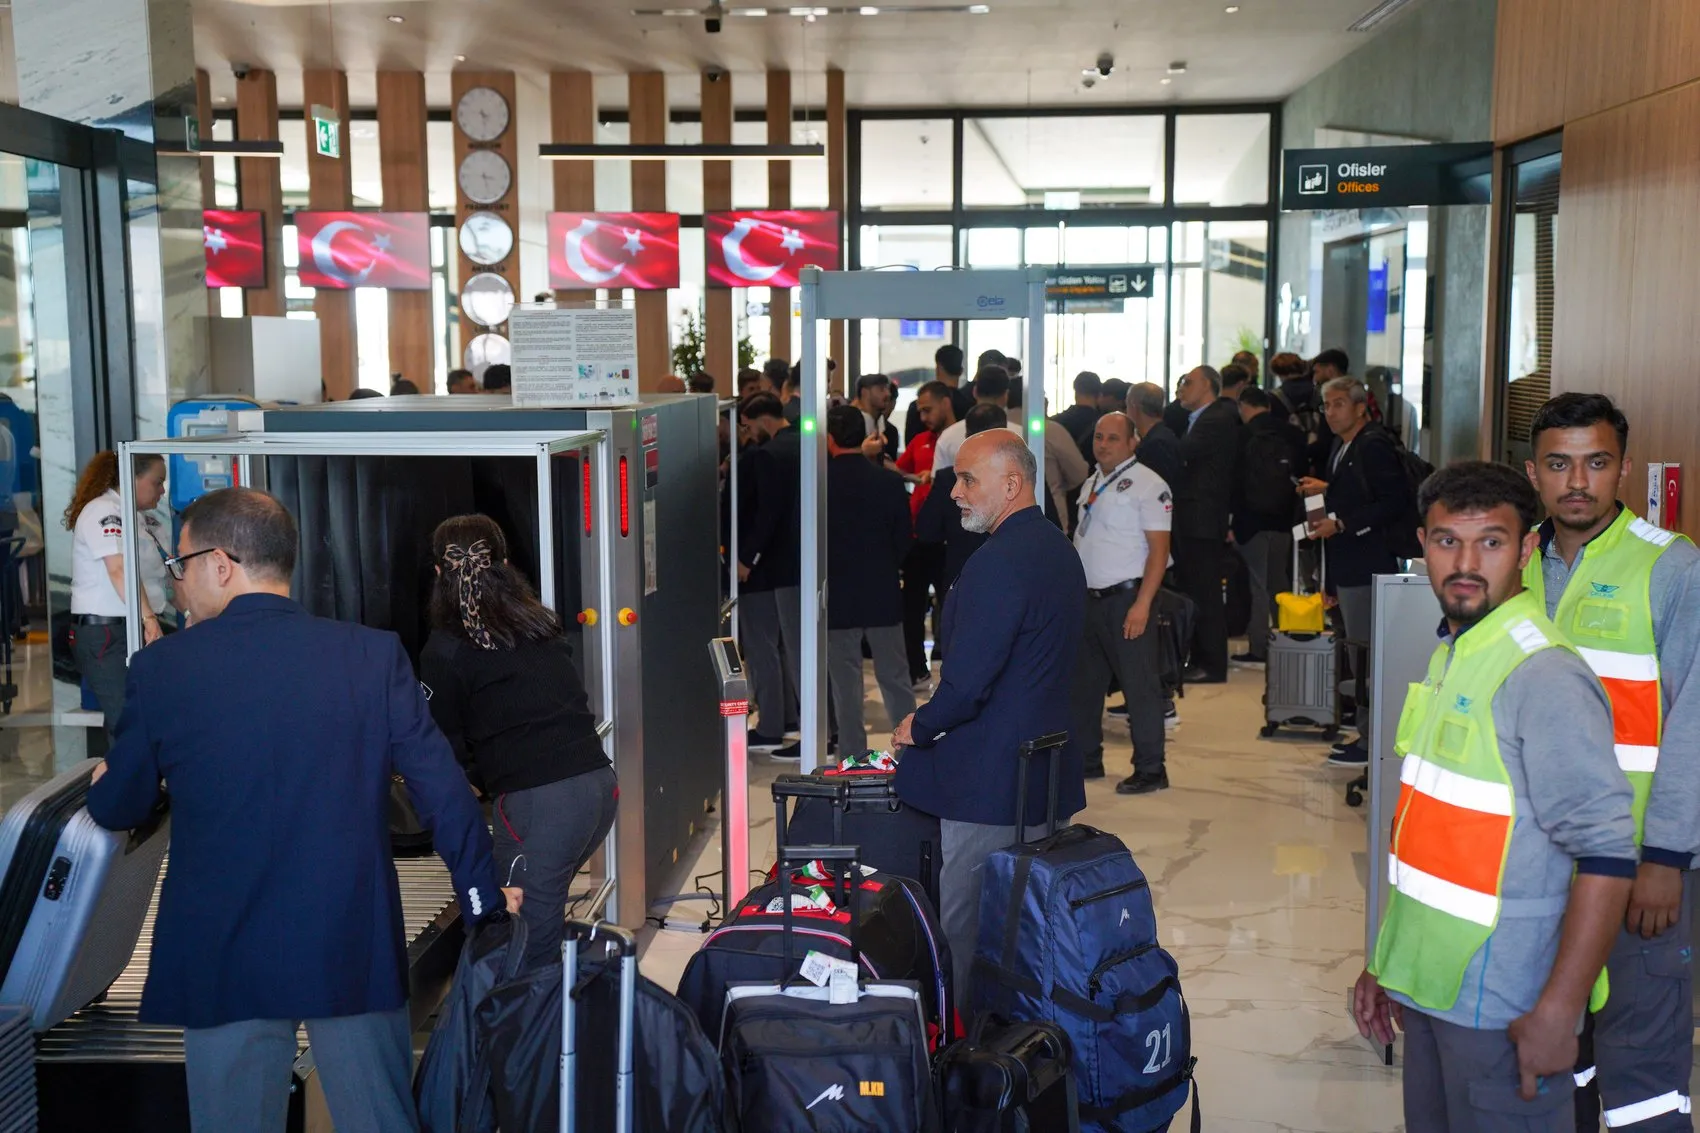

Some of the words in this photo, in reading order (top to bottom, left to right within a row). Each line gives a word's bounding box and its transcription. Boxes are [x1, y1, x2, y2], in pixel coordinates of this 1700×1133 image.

[1337, 163, 1387, 178] Ofisler
[1337, 181, 1380, 194] Offices
[1142, 1022, 1172, 1075] 21
